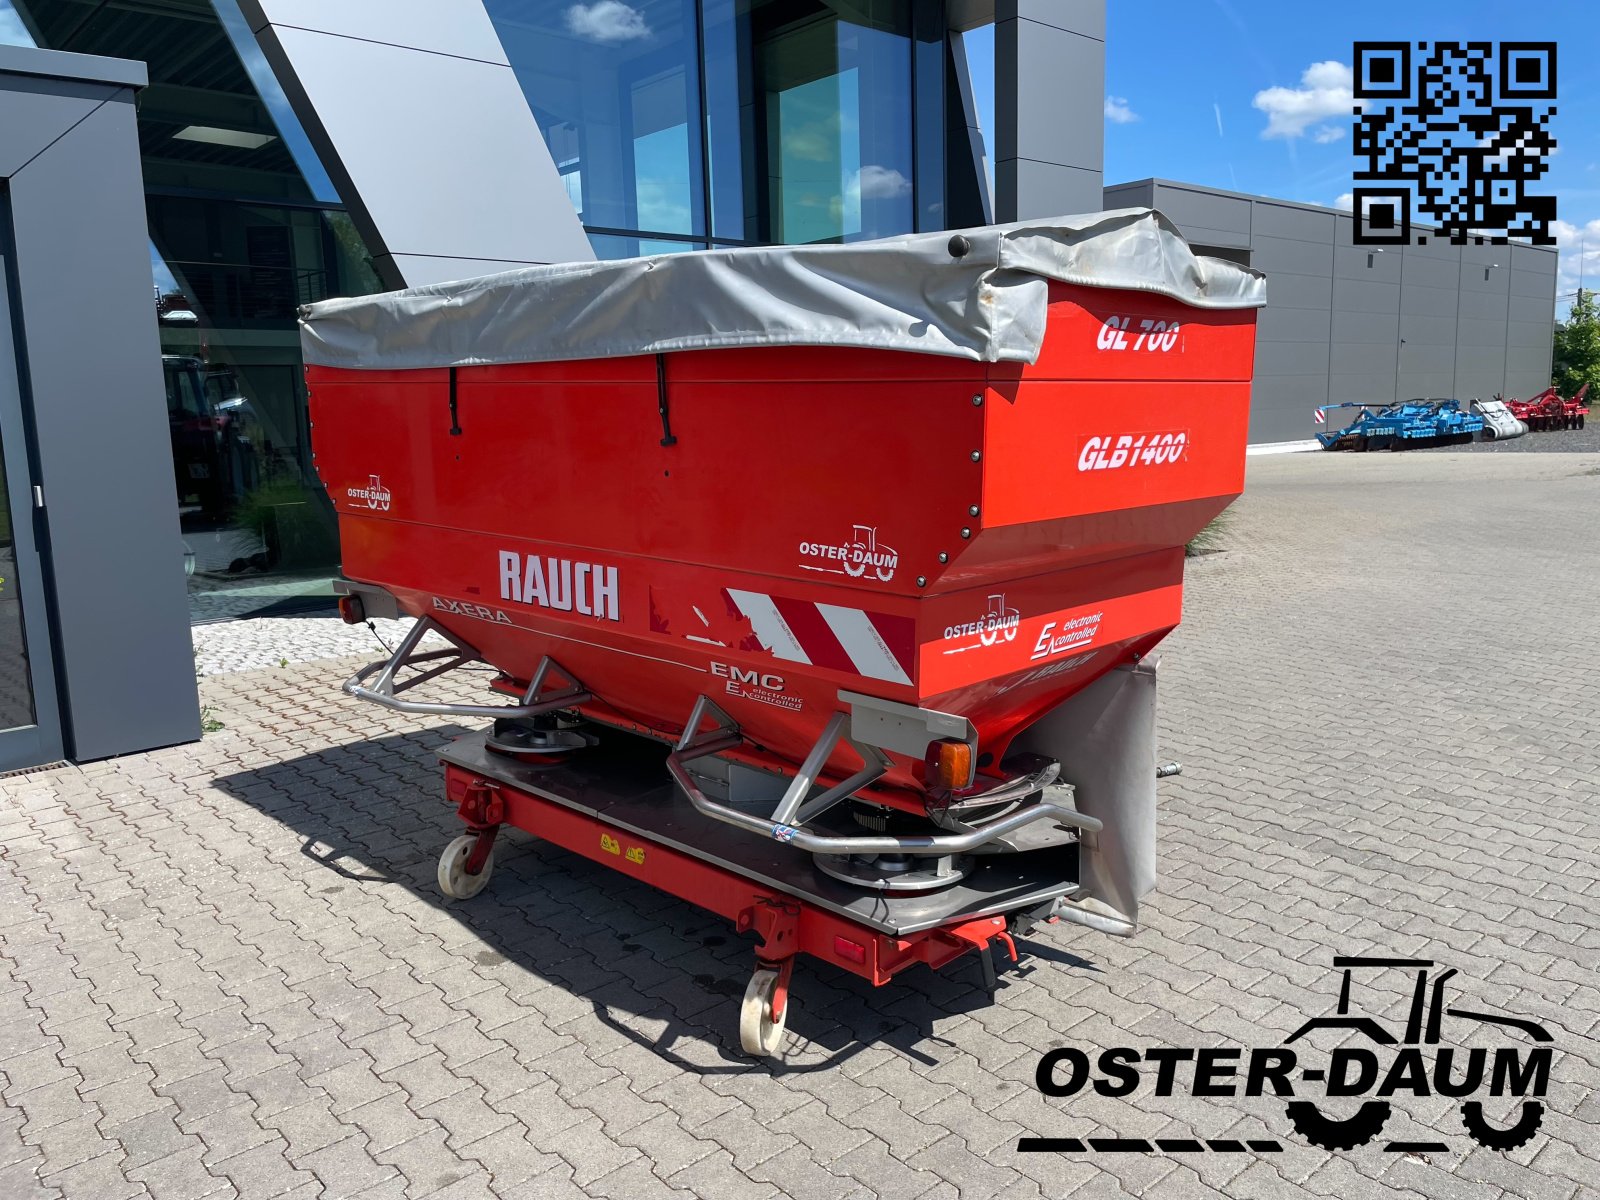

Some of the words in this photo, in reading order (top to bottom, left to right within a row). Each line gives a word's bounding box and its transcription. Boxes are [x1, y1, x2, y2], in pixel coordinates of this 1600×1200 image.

[1097, 315, 1131, 351] GL
[1132, 319, 1180, 352] 700
[347, 488, 391, 502] OSTER-DAUM
[799, 541, 898, 569] OSTER-DAUM
[498, 550, 620, 622] RAUCH
[432, 596, 513, 625] AXERA
[1063, 611, 1104, 632] electronic
[943, 614, 1020, 640] OSTER-DAUM
[1054, 624, 1099, 647] controlled
[710, 660, 785, 692] EMC
[748, 692, 803, 710] controlled
[752, 688, 804, 704] electronic
